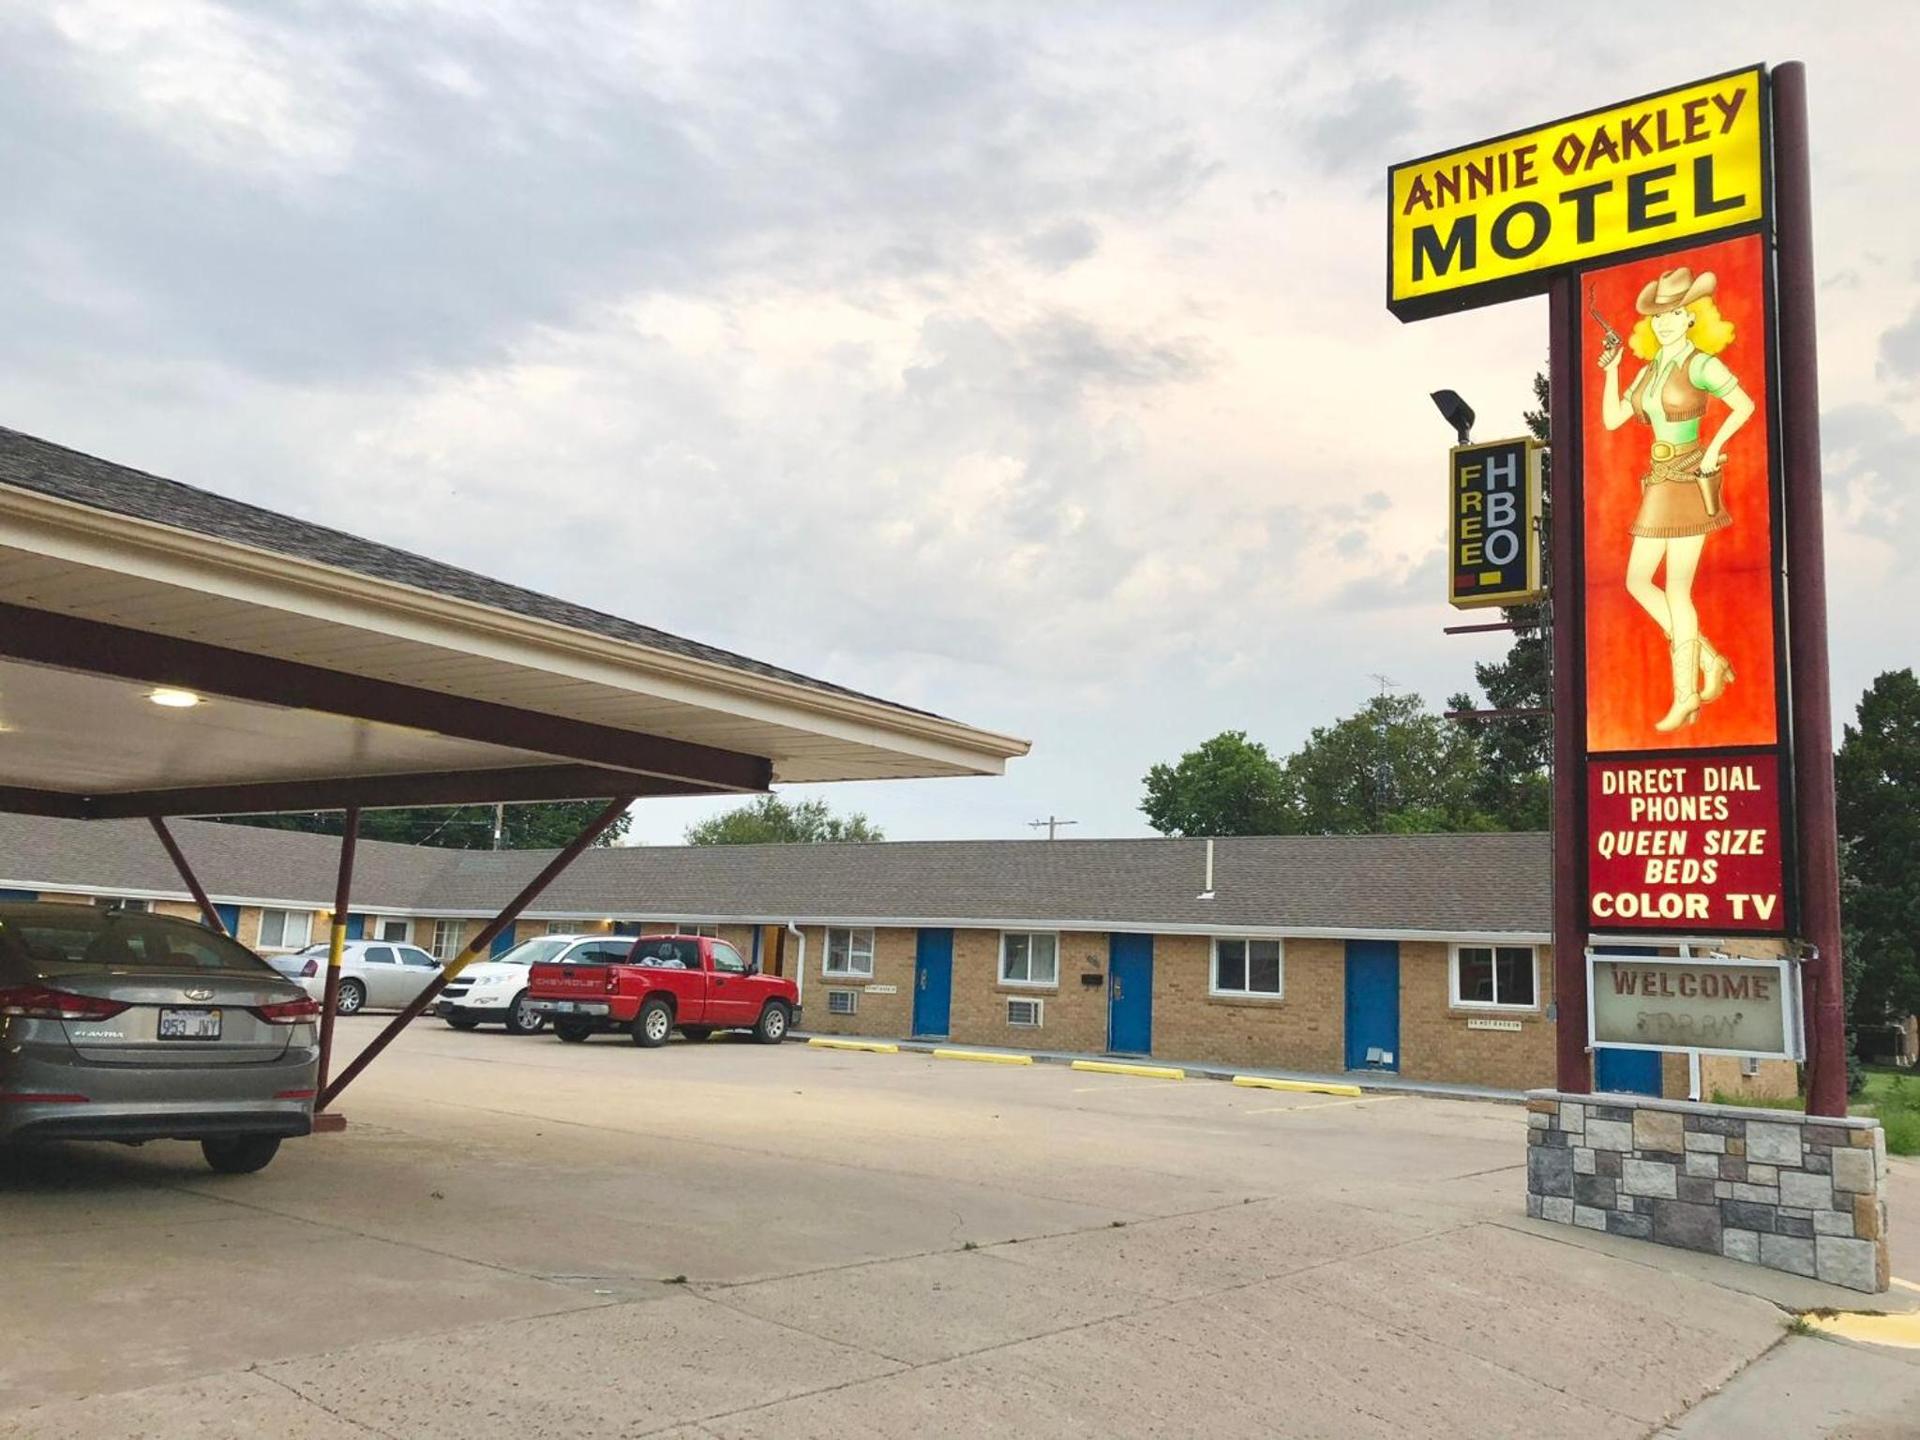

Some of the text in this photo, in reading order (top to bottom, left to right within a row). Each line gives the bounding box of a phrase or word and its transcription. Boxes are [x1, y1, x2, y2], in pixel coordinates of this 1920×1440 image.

[1402, 88, 1748, 216] ANNIE OAKLEY
[1411, 154, 1747, 283] MOTEL
[1460, 465, 1483, 566] FREE
[1485, 453, 1519, 565] HBO
[1602, 766, 1761, 795] DIRECT DIAL
[1630, 795, 1729, 822] PHONES
[1598, 829, 1767, 860] QUEEN SIZE
[1644, 859, 1719, 884] BEDS
[1592, 892, 1777, 920] COLOR TV
[535, 978, 602, 987] CHEVROLET
[1611, 967, 1771, 1000] WELCOME
